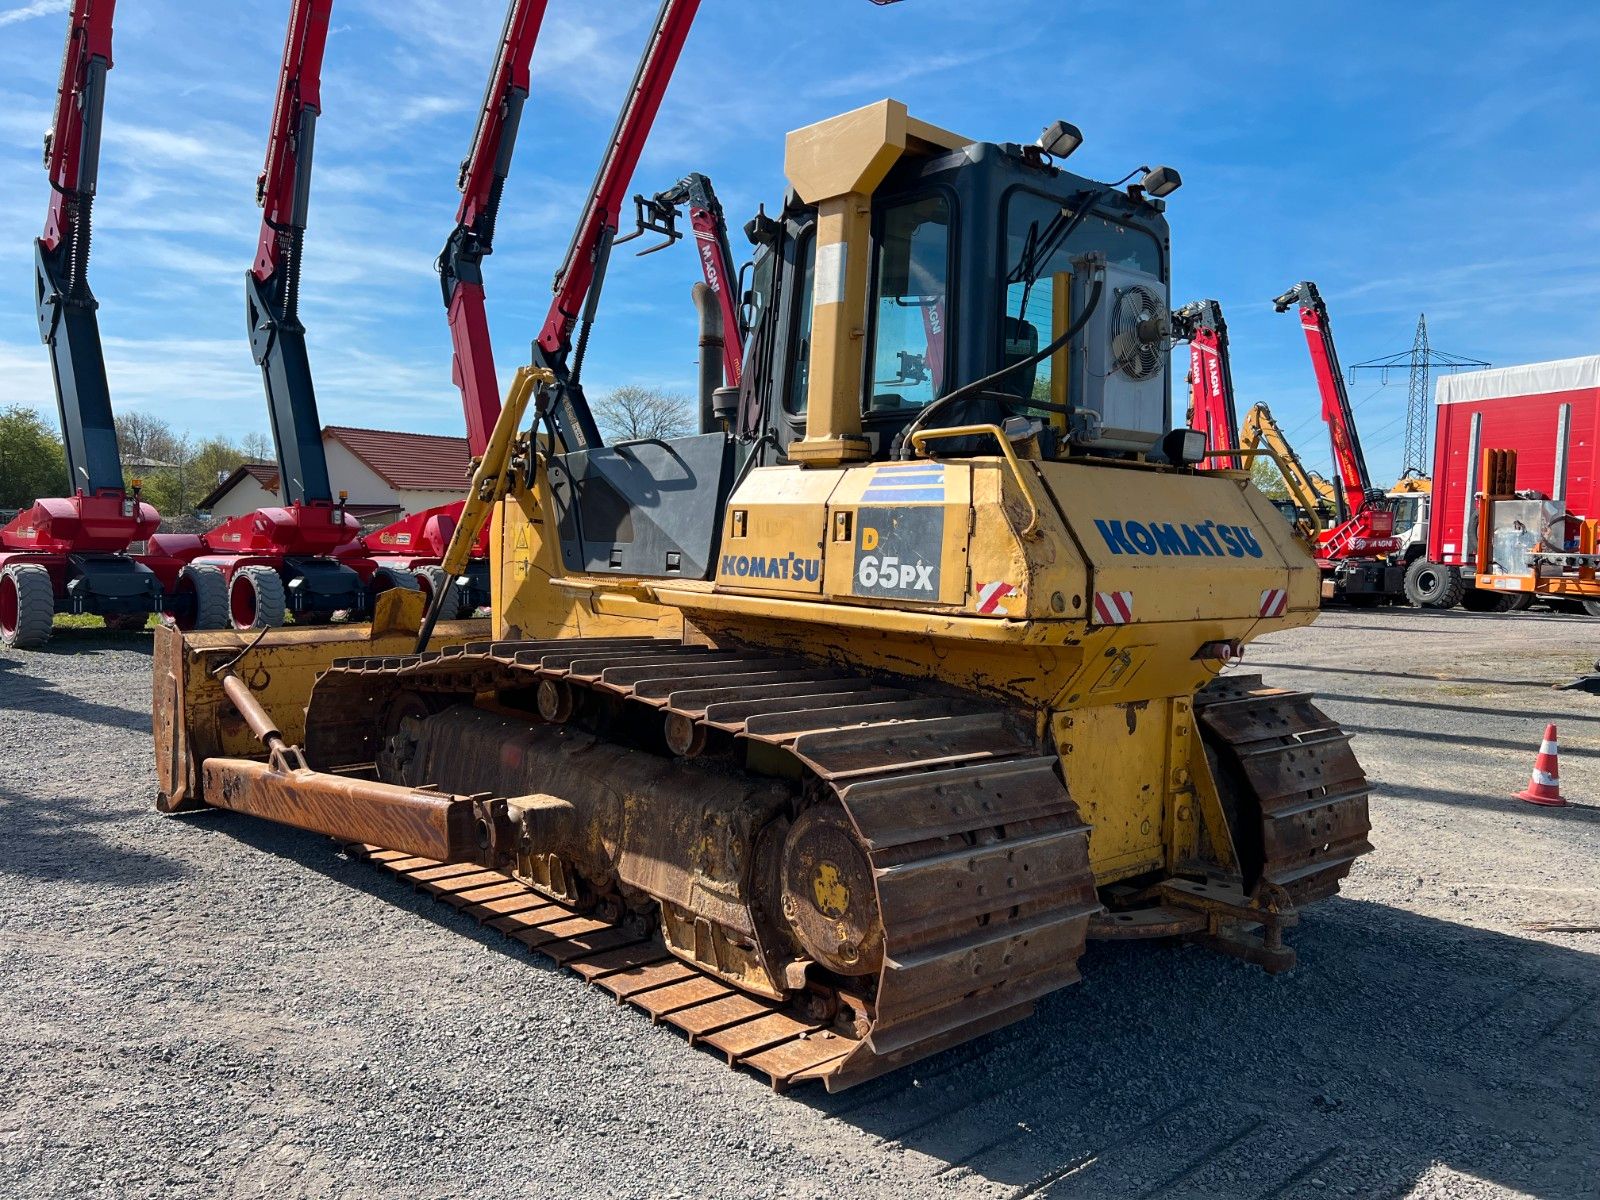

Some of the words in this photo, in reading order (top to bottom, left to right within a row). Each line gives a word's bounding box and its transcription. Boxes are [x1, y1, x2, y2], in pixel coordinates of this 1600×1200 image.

[702, 245, 720, 292] MAGNI
[1209, 358, 1220, 397] MAGNI
[862, 527, 879, 551] D
[1093, 519, 1264, 559] KOMATSU
[721, 551, 820, 583] KOMATSU
[858, 555, 934, 591] 65PX
